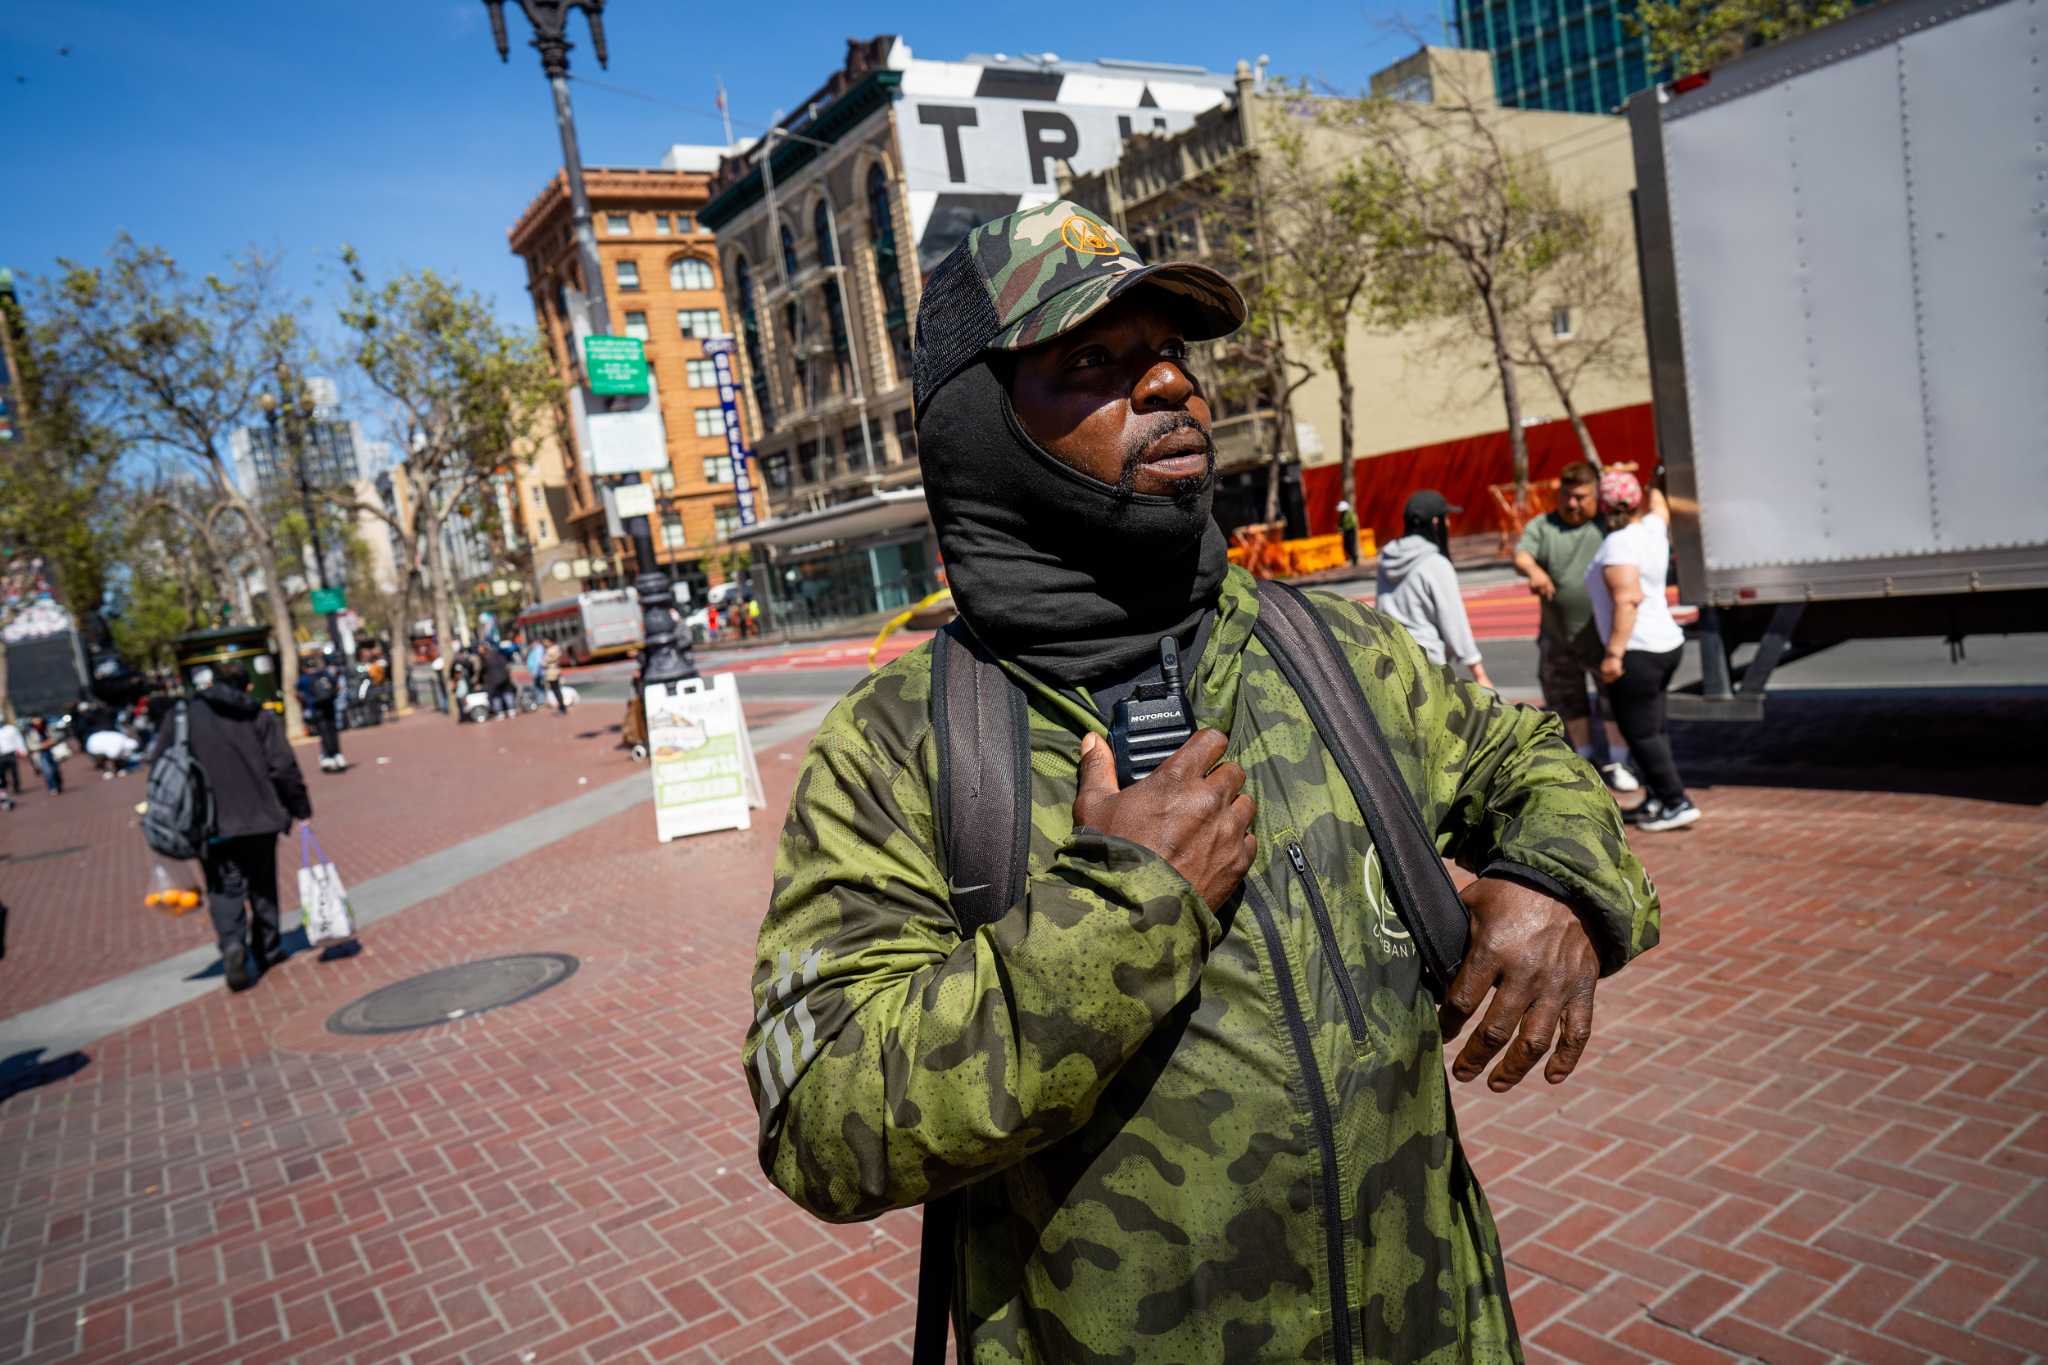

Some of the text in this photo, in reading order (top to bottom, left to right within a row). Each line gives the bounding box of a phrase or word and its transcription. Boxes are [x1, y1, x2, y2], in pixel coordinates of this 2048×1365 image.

[725, 410, 755, 524] FELLOWS
[1130, 710, 1181, 722] MOTOROLA
[1372, 923, 1408, 958] UBAN
